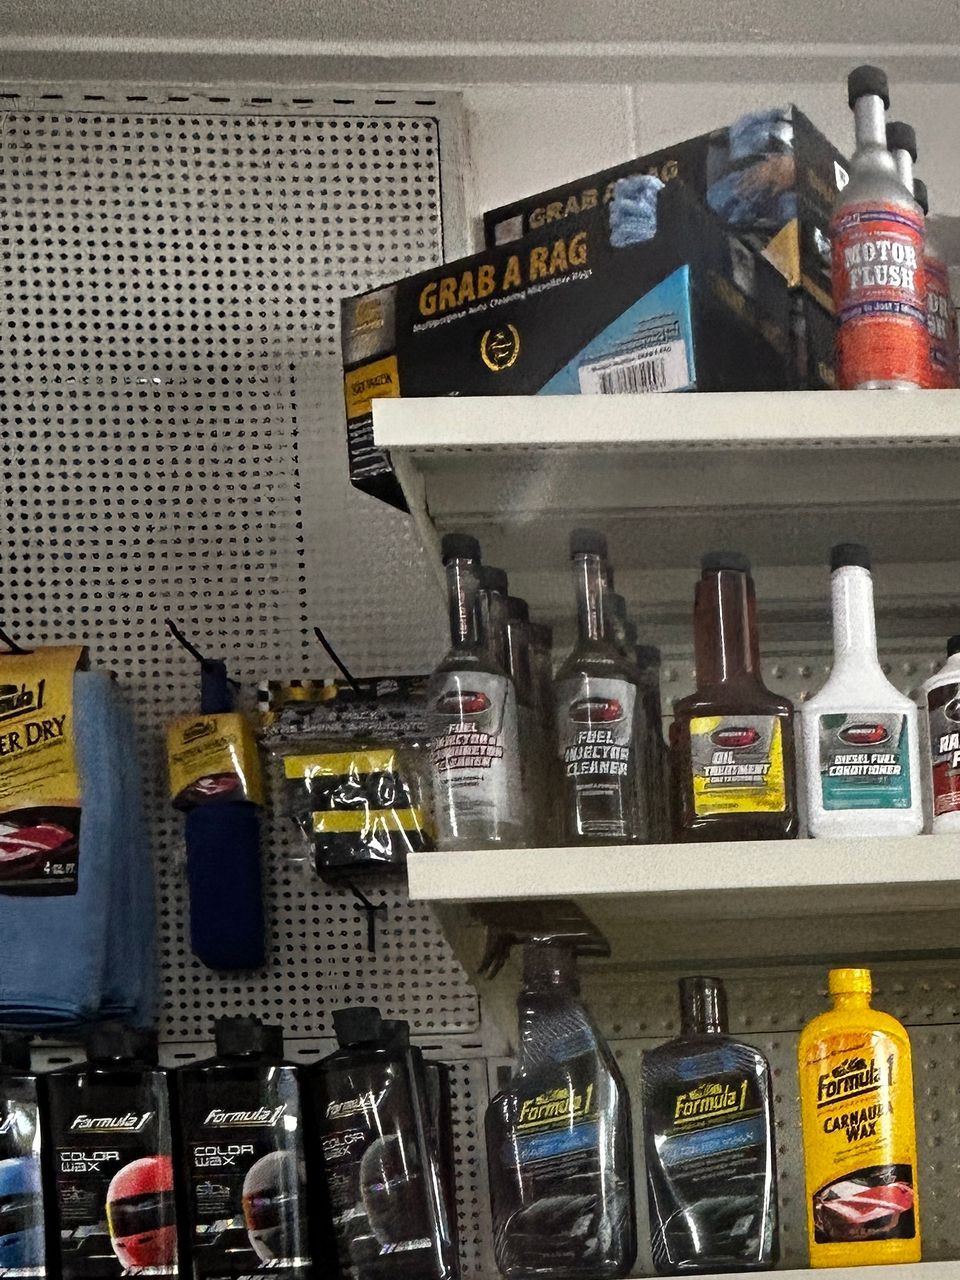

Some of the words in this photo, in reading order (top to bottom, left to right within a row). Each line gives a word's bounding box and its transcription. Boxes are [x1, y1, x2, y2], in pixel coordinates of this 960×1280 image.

[844, 240, 918, 270] MOTOR
[418, 264, 496, 316] GRAB
[502, 255, 522, 291] A
[529, 231, 588, 282] RAG
[849, 263, 916, 291] FLUSH
[24, 714, 67, 747] DRY
[578, 730, 614, 745] FUEL
[675, 1084, 737, 1118] Formula
[70, 1112, 138, 1130] Formula
[203, 1105, 270, 1125] Formula
[845, 1120, 877, 1144] WAX
[60, 1151, 120, 1162] COLOR
[194, 1144, 254, 1156] COLOR
